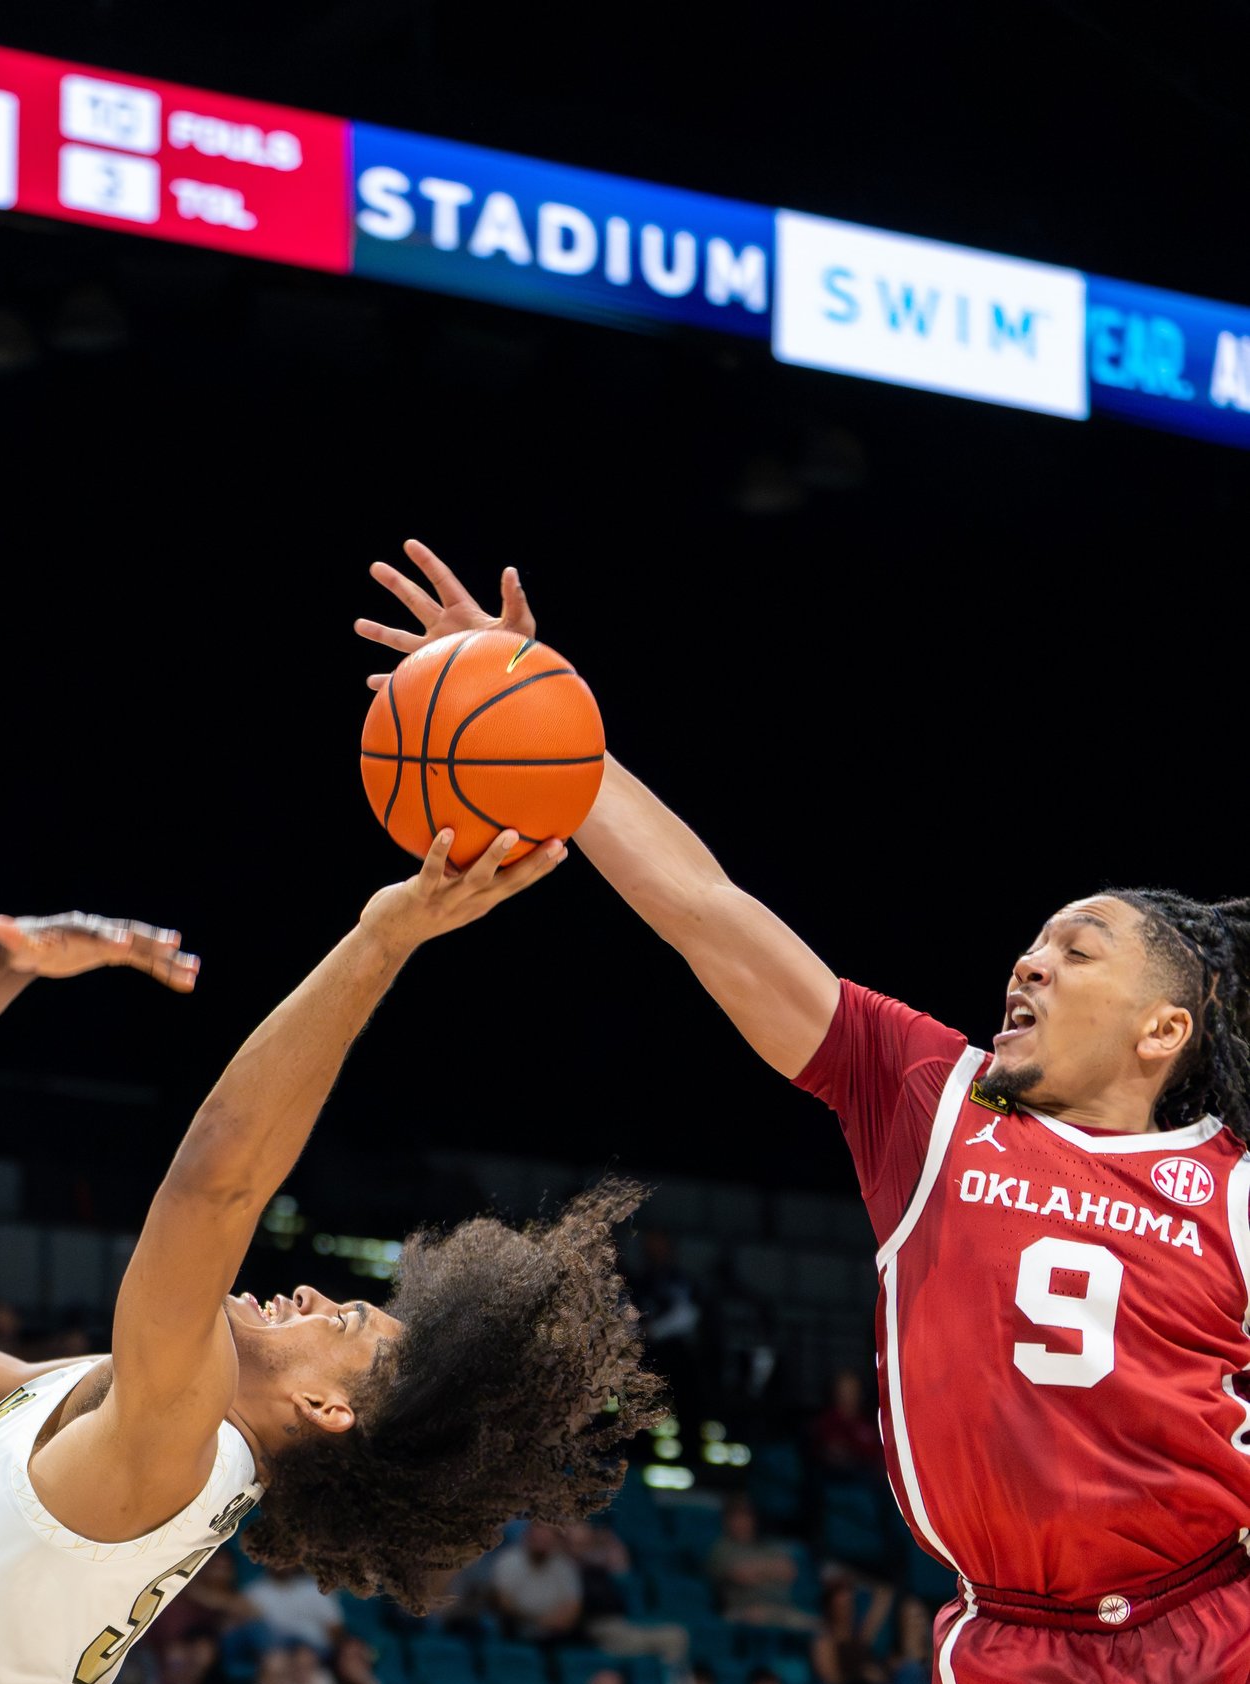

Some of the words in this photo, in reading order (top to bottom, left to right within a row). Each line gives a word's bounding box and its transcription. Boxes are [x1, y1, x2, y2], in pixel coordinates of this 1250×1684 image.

[168, 110, 302, 171] FOULS
[356, 166, 769, 314] STADIUM
[820, 264, 1040, 360] SWIM
[1088, 303, 1196, 400] EAR.
[959, 1169, 1203, 1257] OKLAHOMA
[1156, 1160, 1210, 1204] SEC
[1013, 1236, 1125, 1389] 9
